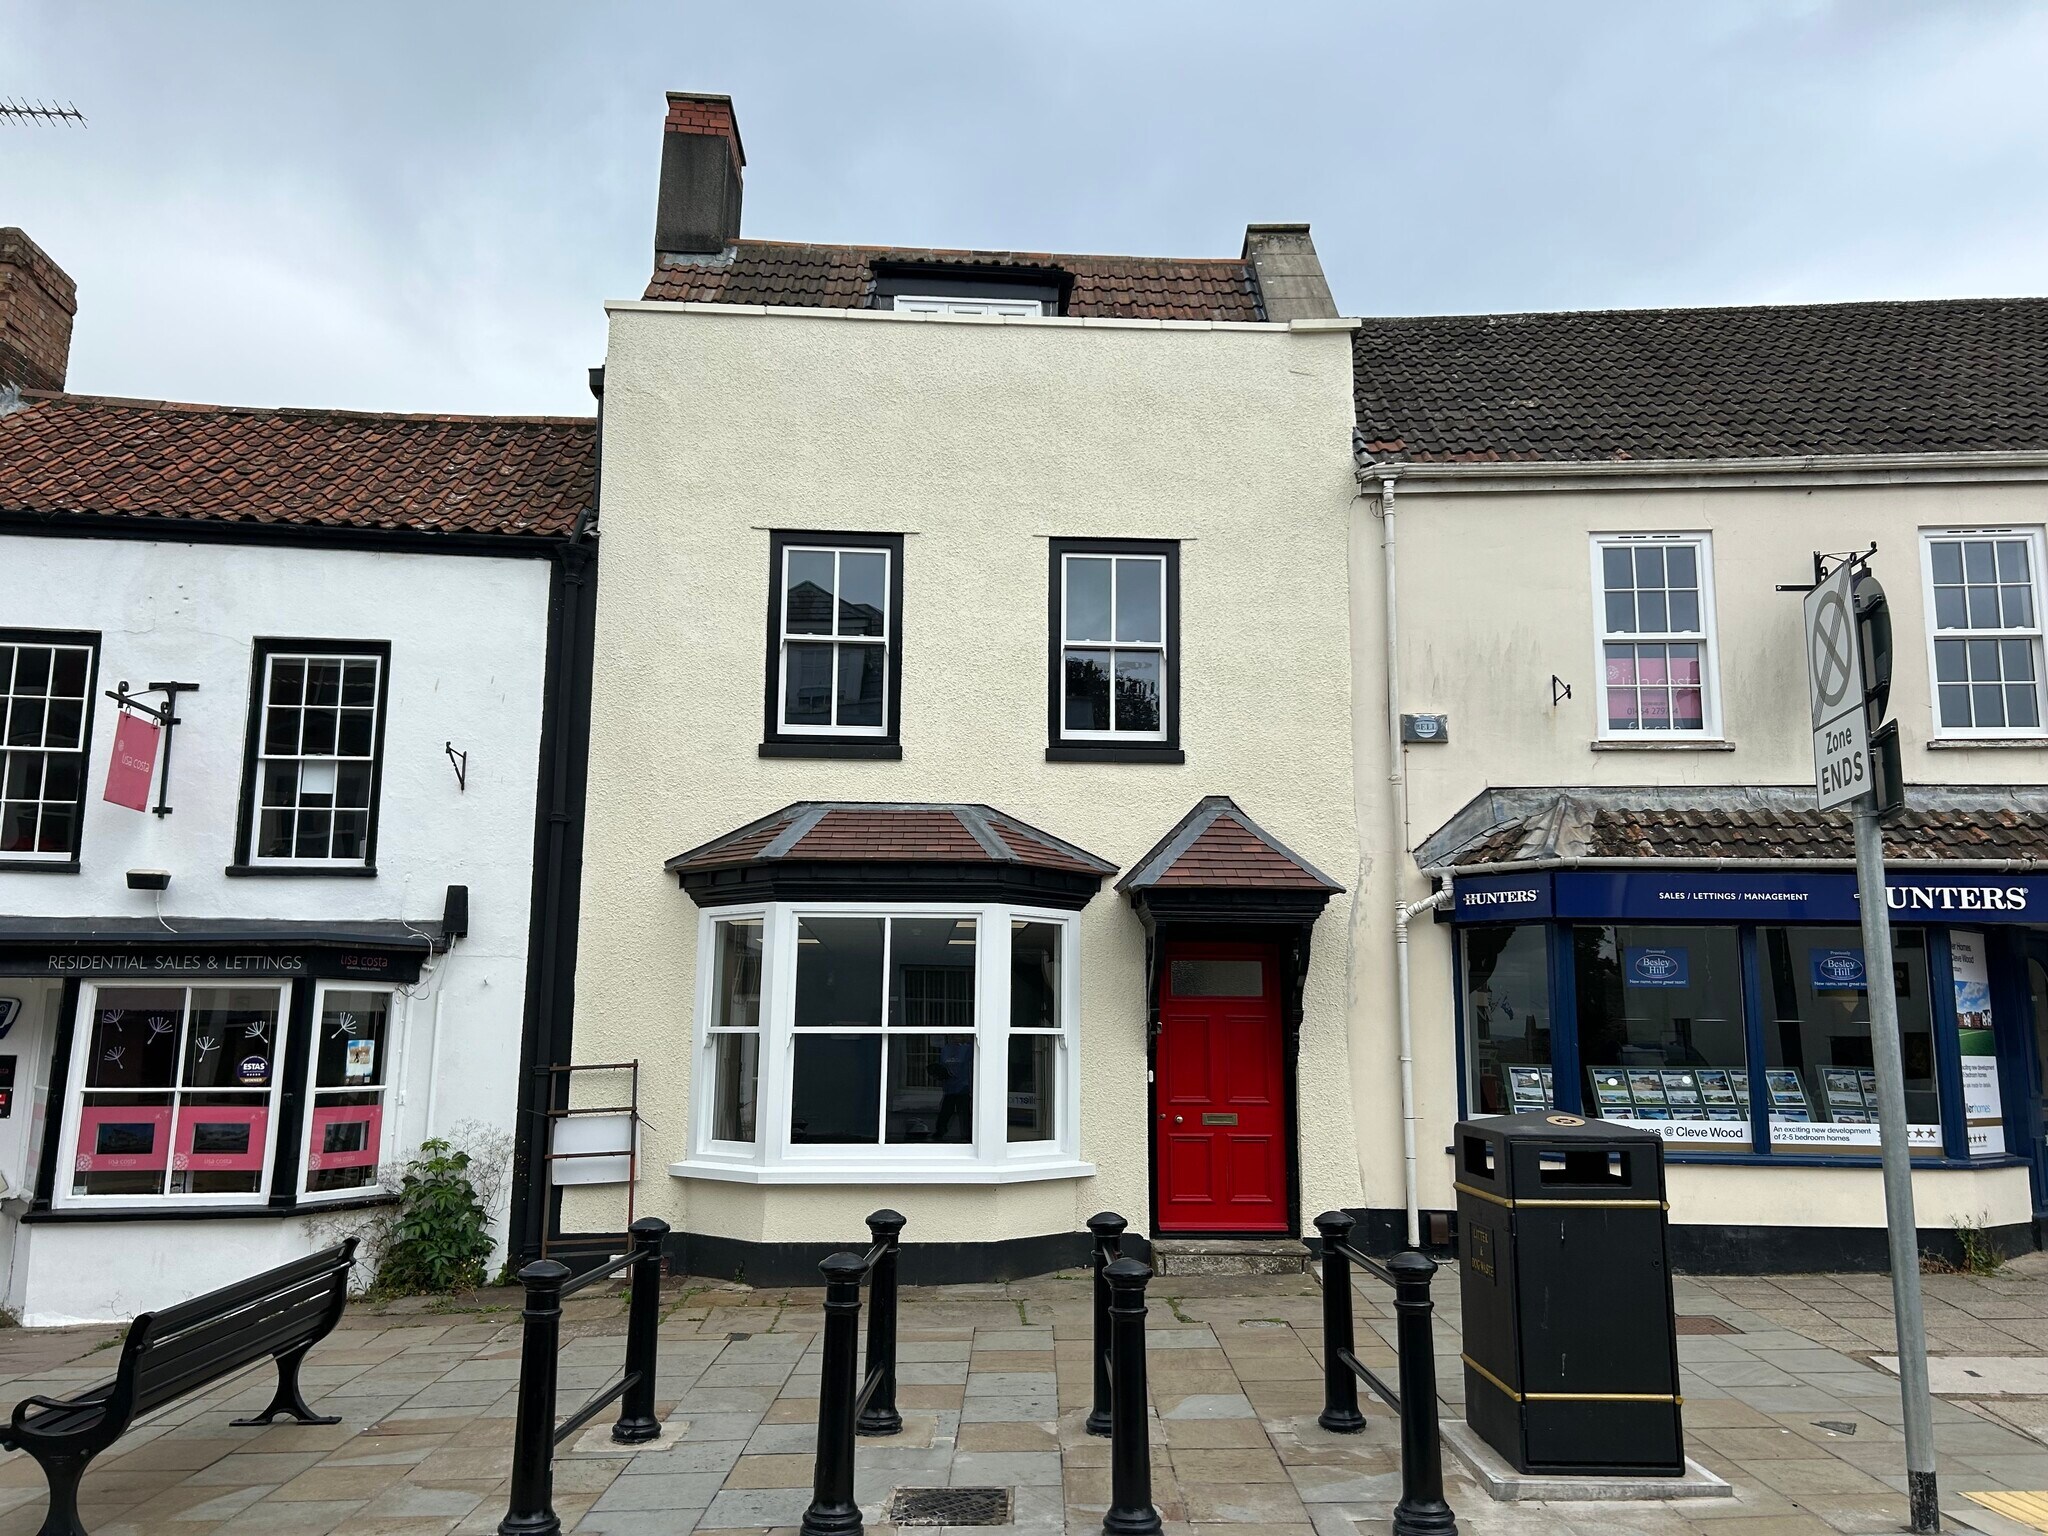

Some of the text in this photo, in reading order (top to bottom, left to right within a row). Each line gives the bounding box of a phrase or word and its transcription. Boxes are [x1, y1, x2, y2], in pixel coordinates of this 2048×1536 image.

[1626, 706, 1679, 716] 0154 2794
[1415, 723, 1437, 731] BELL
[1825, 727, 1852, 755] Zone
[121, 753, 150, 773] lisa costa
[1821, 751, 1864, 796] ENDS
[1463, 889, 1537, 906] HUNTERS
[1658, 892, 1686, 900] SALES
[1693, 892, 1736, 901] LETTINGS
[1744, 893, 1809, 901] MANAGEMENT
[1876, 886, 2028, 911] UNTERS
[48, 955, 302, 970] RESIDENTIAL SALES & LETTINGS
[340, 954, 388, 968] lisa costa
[1643, 958, 1670, 968] Besley
[1827, 959, 1856, 970] Besley
[1649, 966, 1665, 974] Hill
[1834, 968, 1850, 976] Hill
[1664, 1126, 1674, 1137] @
[1676, 1126, 1708, 1138] Cleve
[1709, 1127, 1743, 1138] Wood
[1784, 1126, 1811, 1134] exciting
[1827, 1127, 1871, 1135] development
[119, 1158, 137, 1166] costa
[215, 1158, 233, 1166] costa
